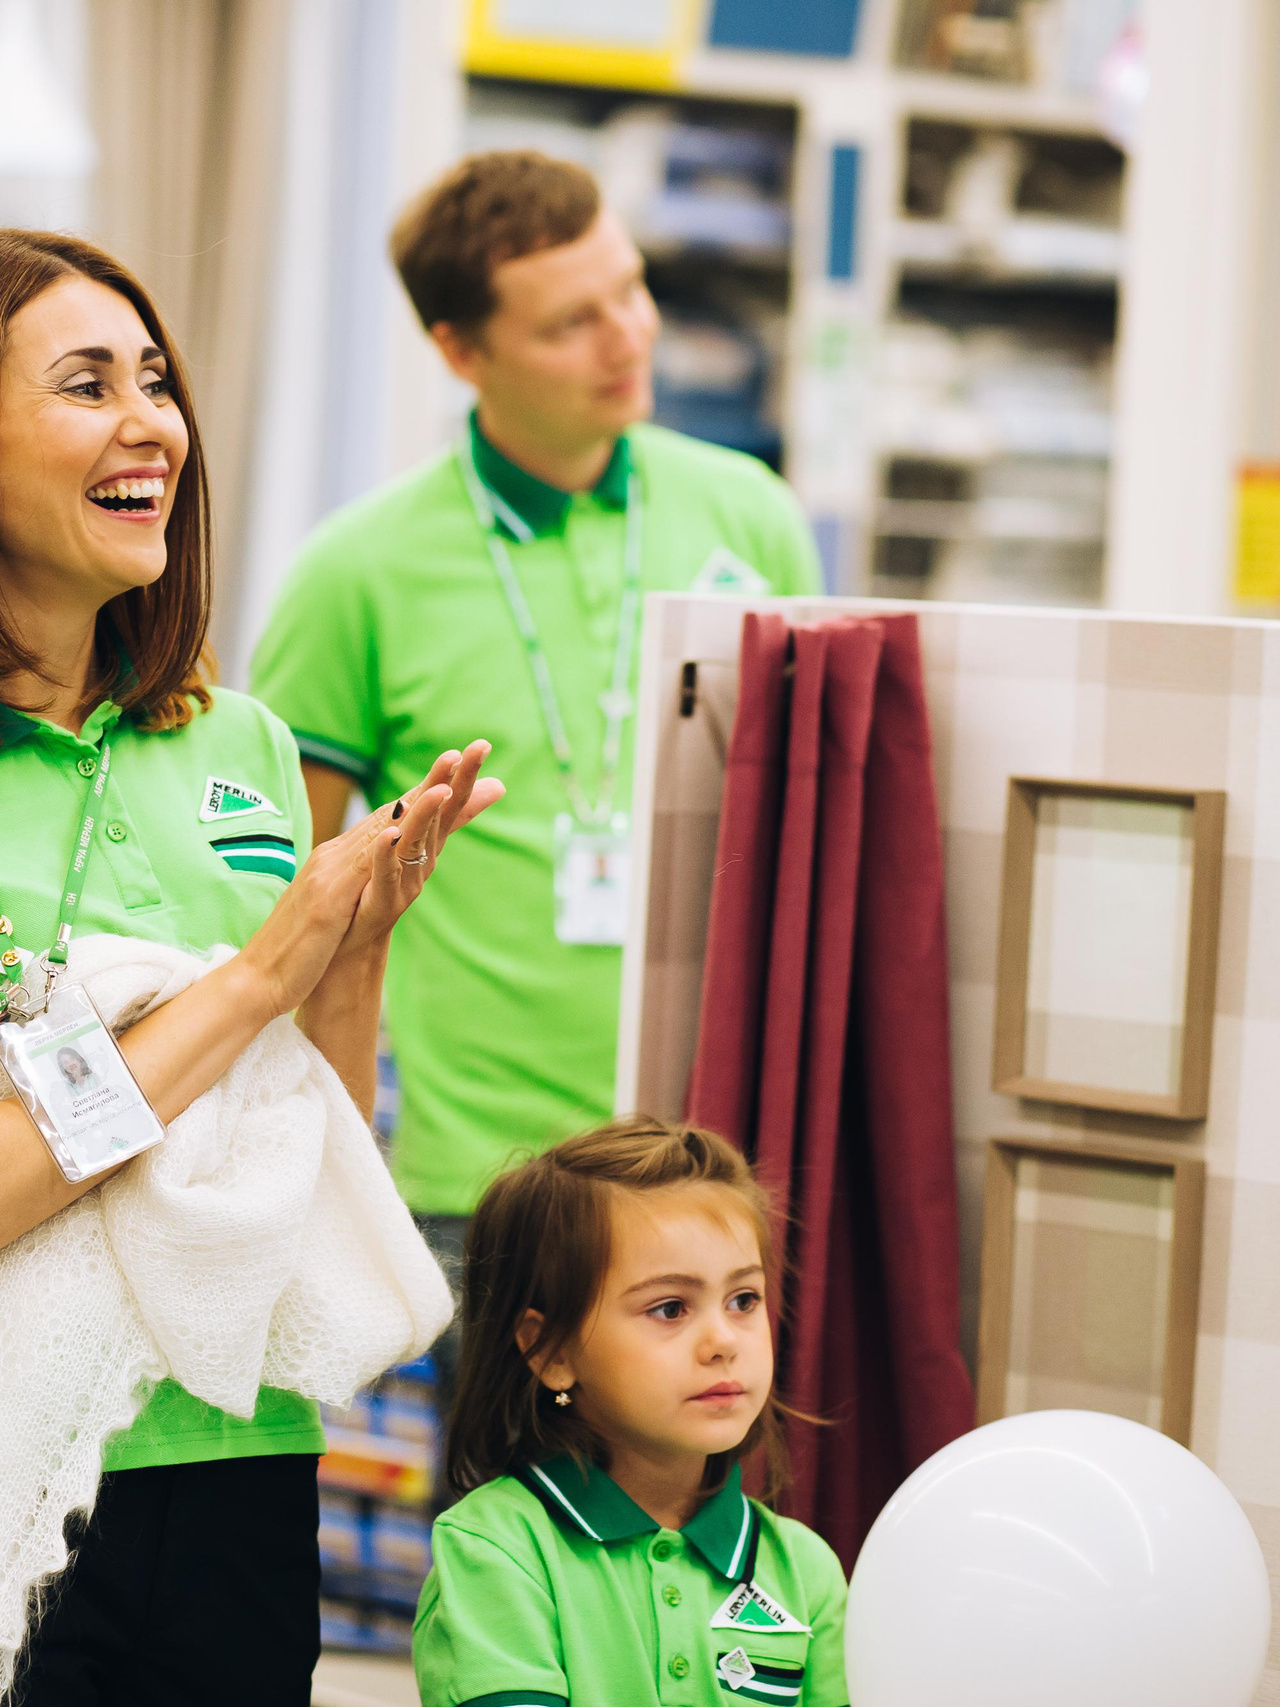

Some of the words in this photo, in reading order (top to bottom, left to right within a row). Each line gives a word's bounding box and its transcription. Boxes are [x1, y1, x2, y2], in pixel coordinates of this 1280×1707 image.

[94, 772, 107, 798] ЛЕРУА
[213, 782, 262, 805] MERLIN
[208, 789, 223, 813] LEROY
[73, 849, 87, 873] ЛЕРУА
[80, 815, 95, 848] МЕРЛЕН
[71, 1093, 120, 1119] Исмагилова
[72, 1087, 110, 1108] Светлана
[725, 1591, 748, 1619] LEROY
